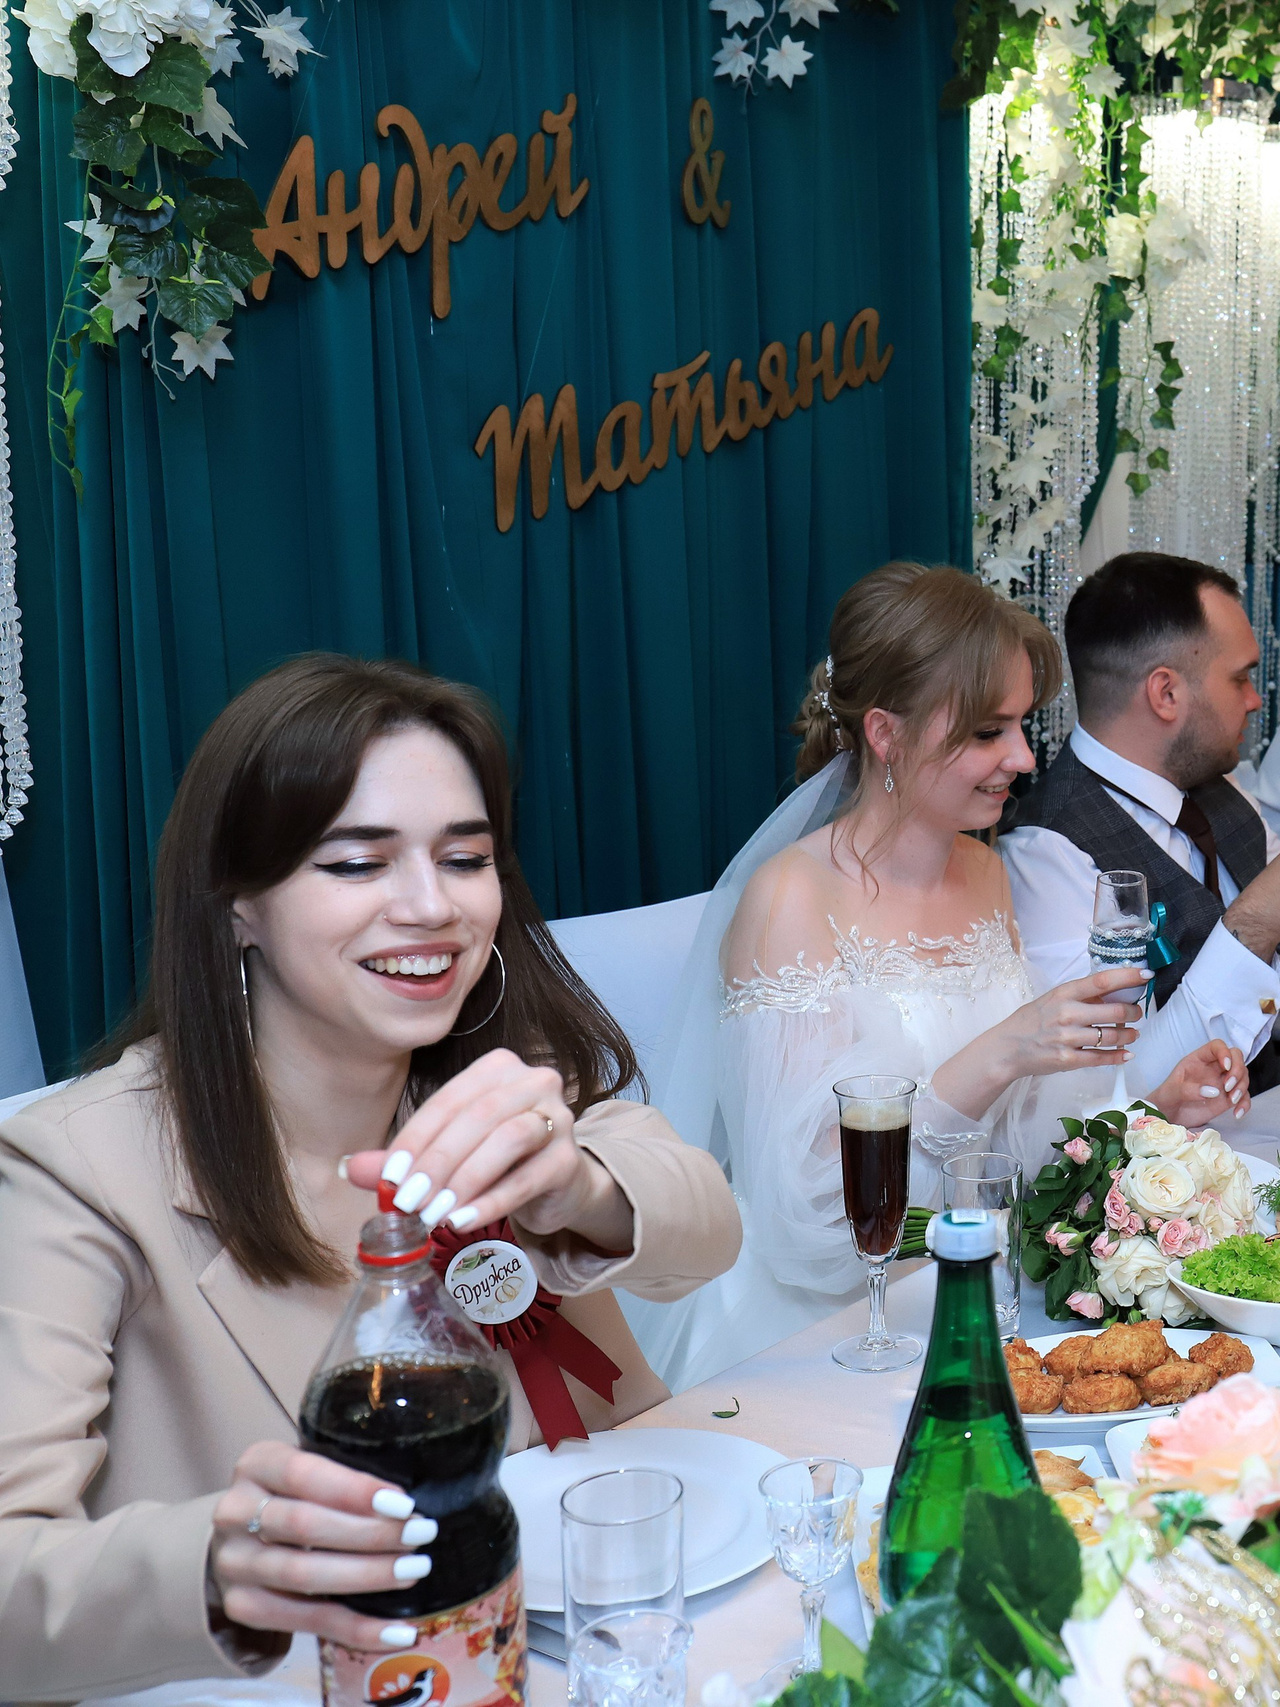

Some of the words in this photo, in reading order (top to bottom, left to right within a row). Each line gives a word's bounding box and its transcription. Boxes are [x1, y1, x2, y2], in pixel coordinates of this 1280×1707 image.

[251, 92, 590, 319] Андрей
[681, 97, 732, 229] &
[474, 306, 894, 533] Татьяна
[453, 1257, 522, 1305] Дружка
